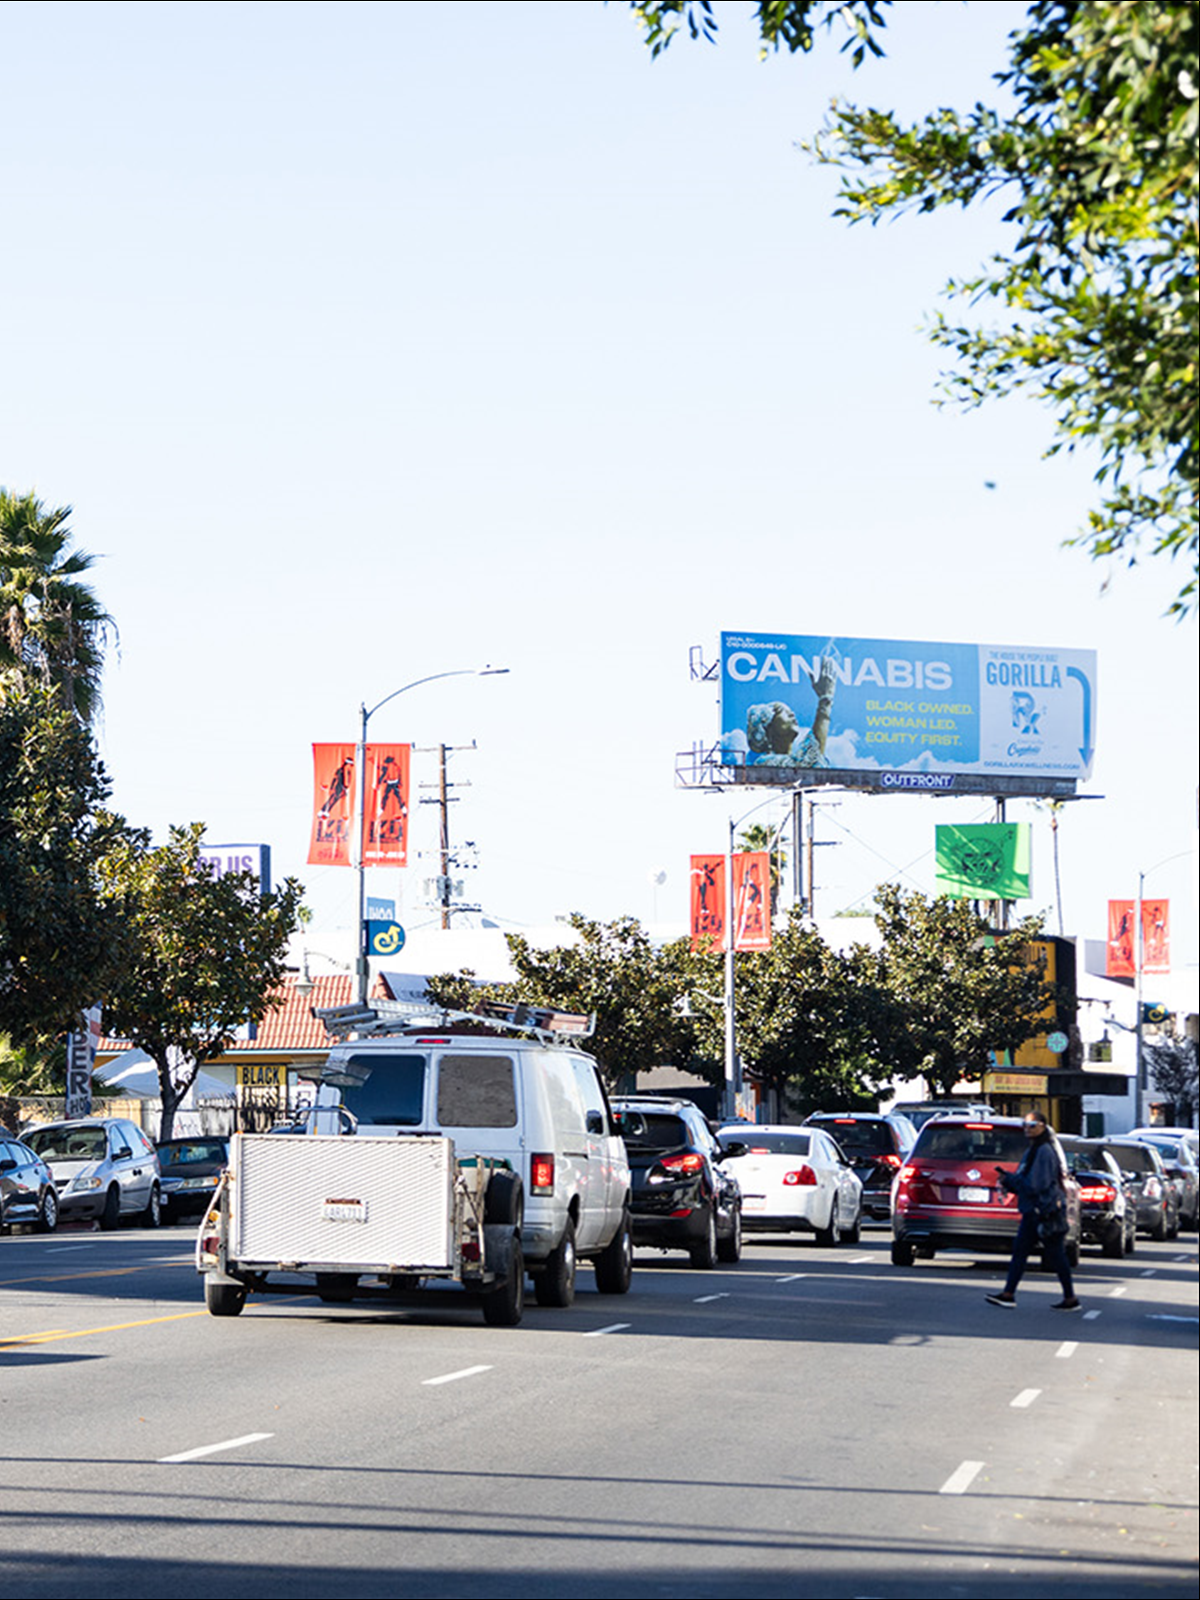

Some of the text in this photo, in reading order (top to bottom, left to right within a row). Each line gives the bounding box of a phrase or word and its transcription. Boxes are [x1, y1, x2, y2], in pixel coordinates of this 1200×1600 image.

[727, 651, 953, 690] CANNABIS
[986, 661, 1062, 688] GORILLA
[866, 700, 974, 714] BLACK OWNED.
[866, 716, 958, 730] WOMAN LED.
[866, 732, 963, 746] EQUITY FIRST.
[884, 773, 952, 787] OUTFRONT
[242, 1067, 280, 1085] BLACK
